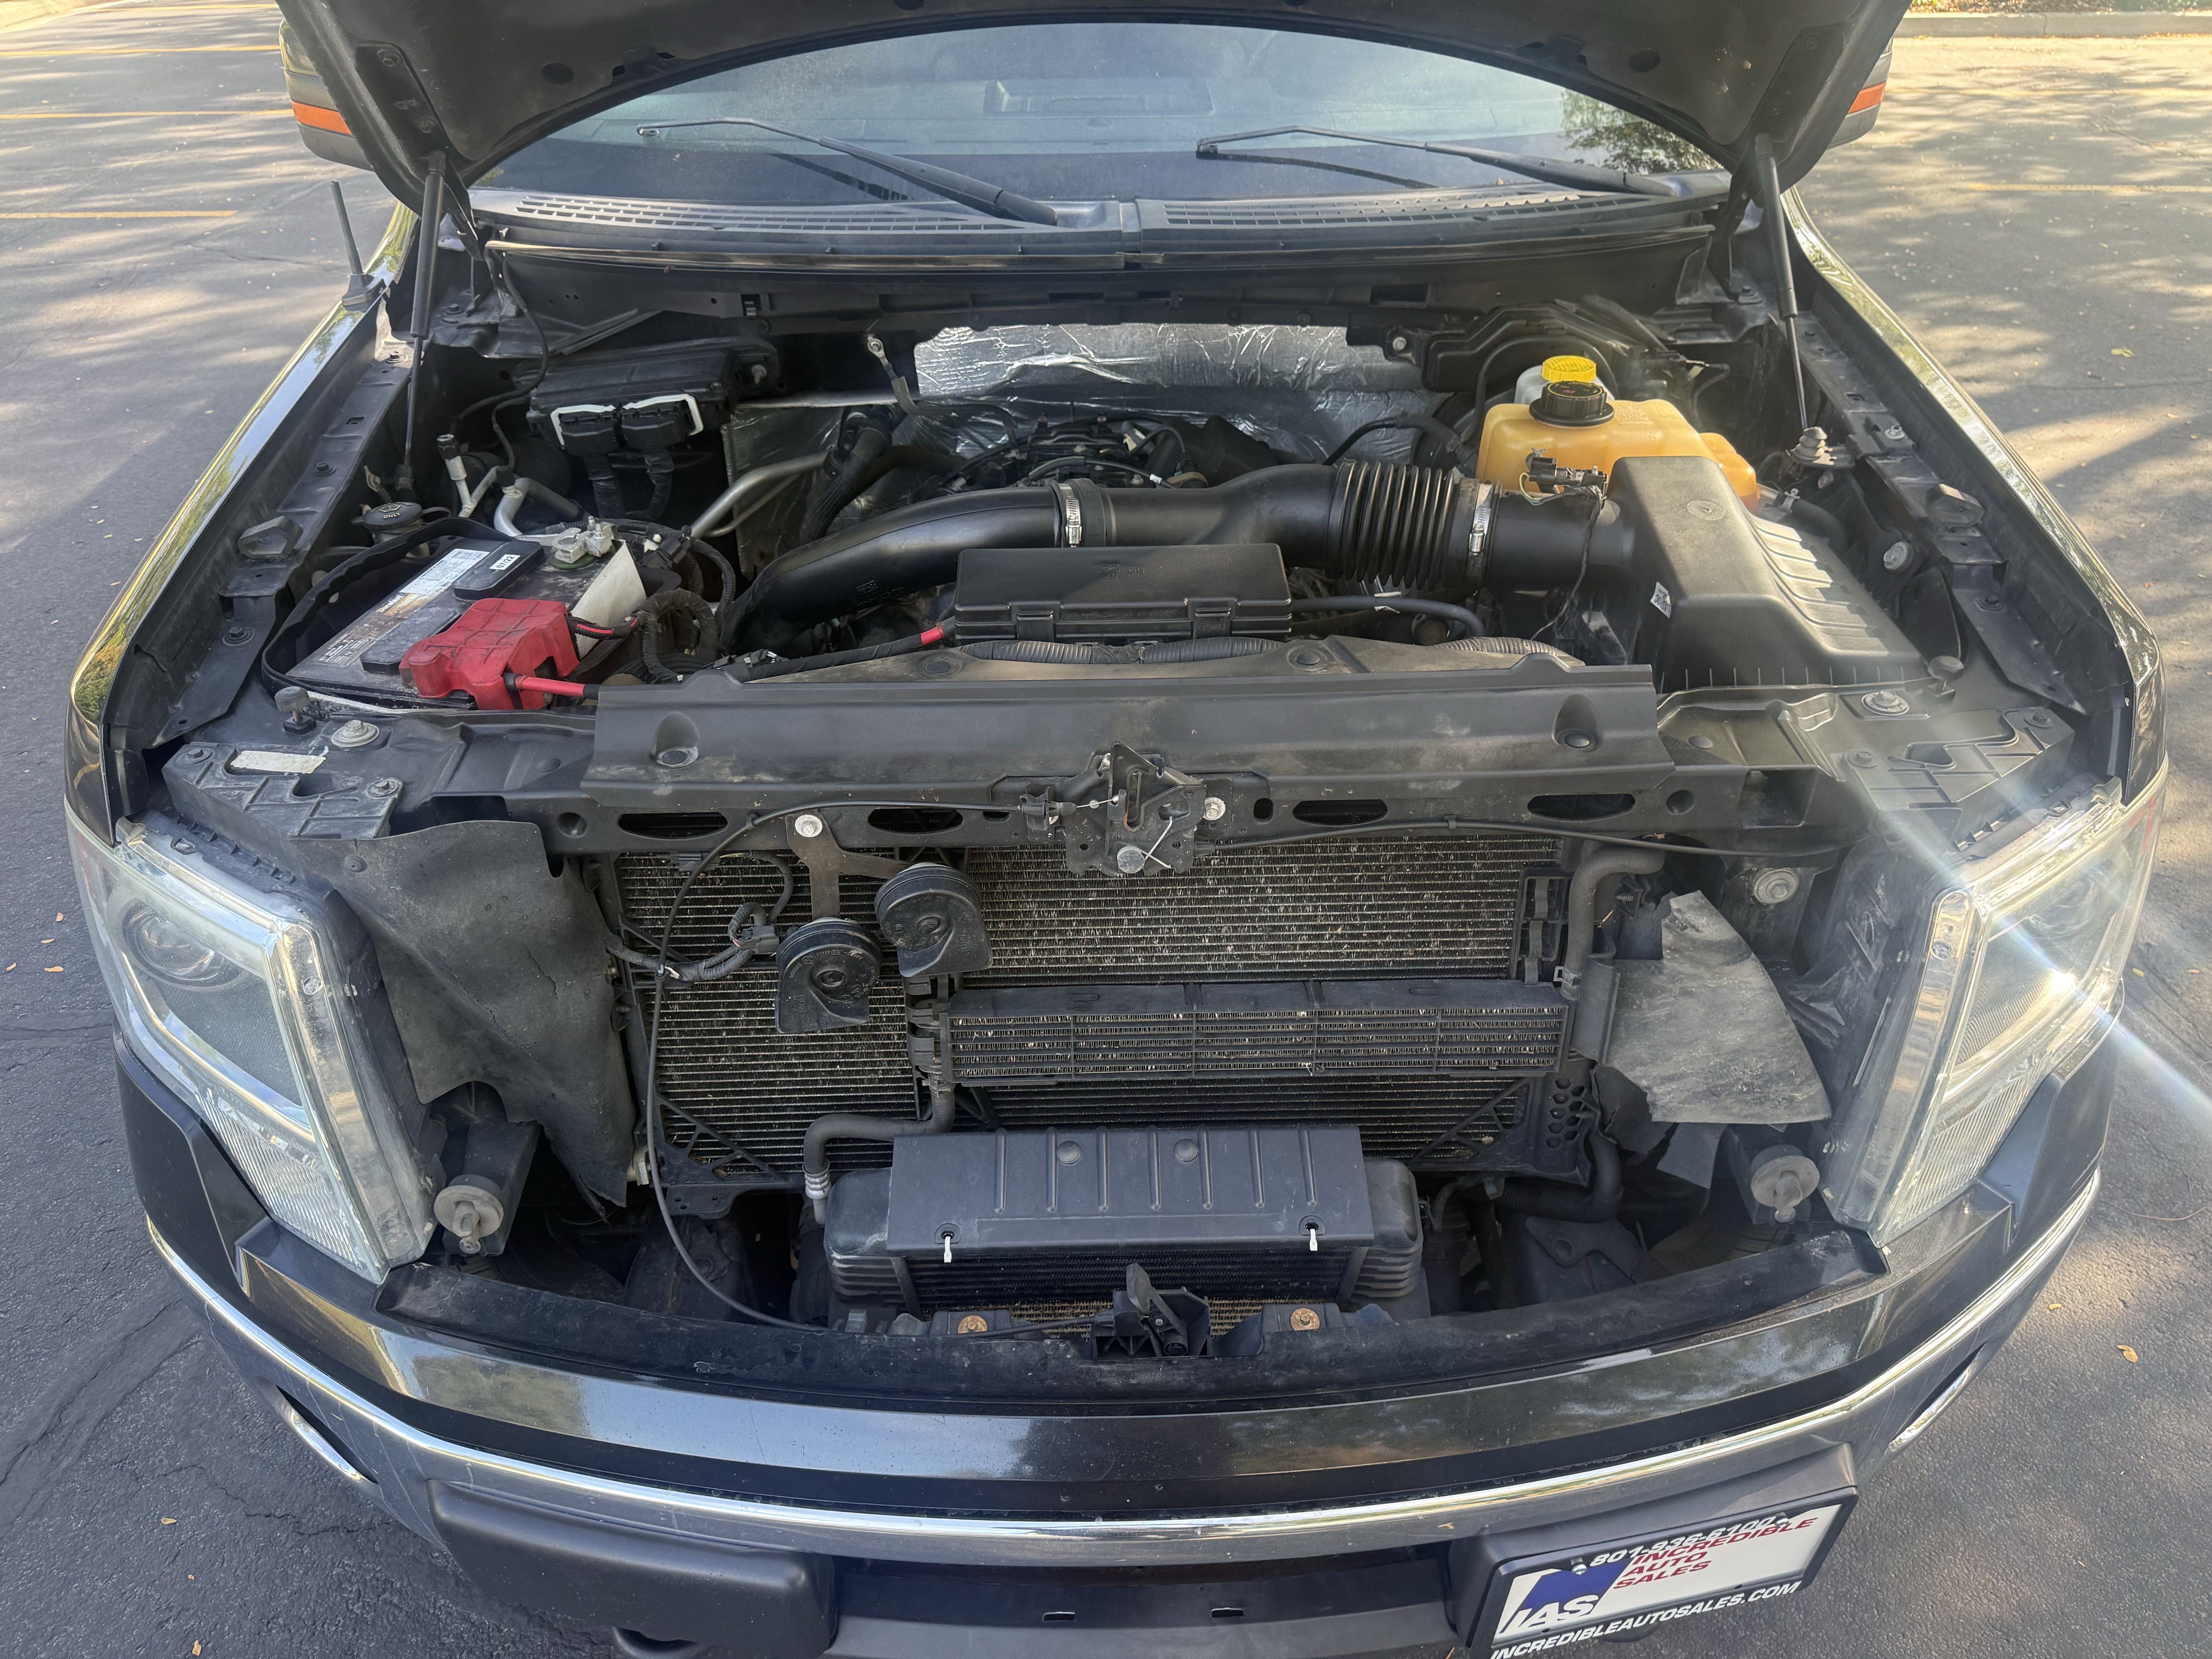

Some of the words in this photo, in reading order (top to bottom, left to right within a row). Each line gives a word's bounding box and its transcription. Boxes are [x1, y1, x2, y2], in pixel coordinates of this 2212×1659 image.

[496, 556, 515, 568] 07/22
[1589, 1516, 1776, 1567] 801-936-6100
[1632, 1517, 1818, 1565] INCREDIBLE
[1613, 1560, 1712, 1589] SALES
[1621, 1551, 1708, 1578] AUTO
[1490, 1581, 1802, 1659] INCREDIBLEAUTOSALES.COM
[1499, 1594, 1599, 1634] IAS
